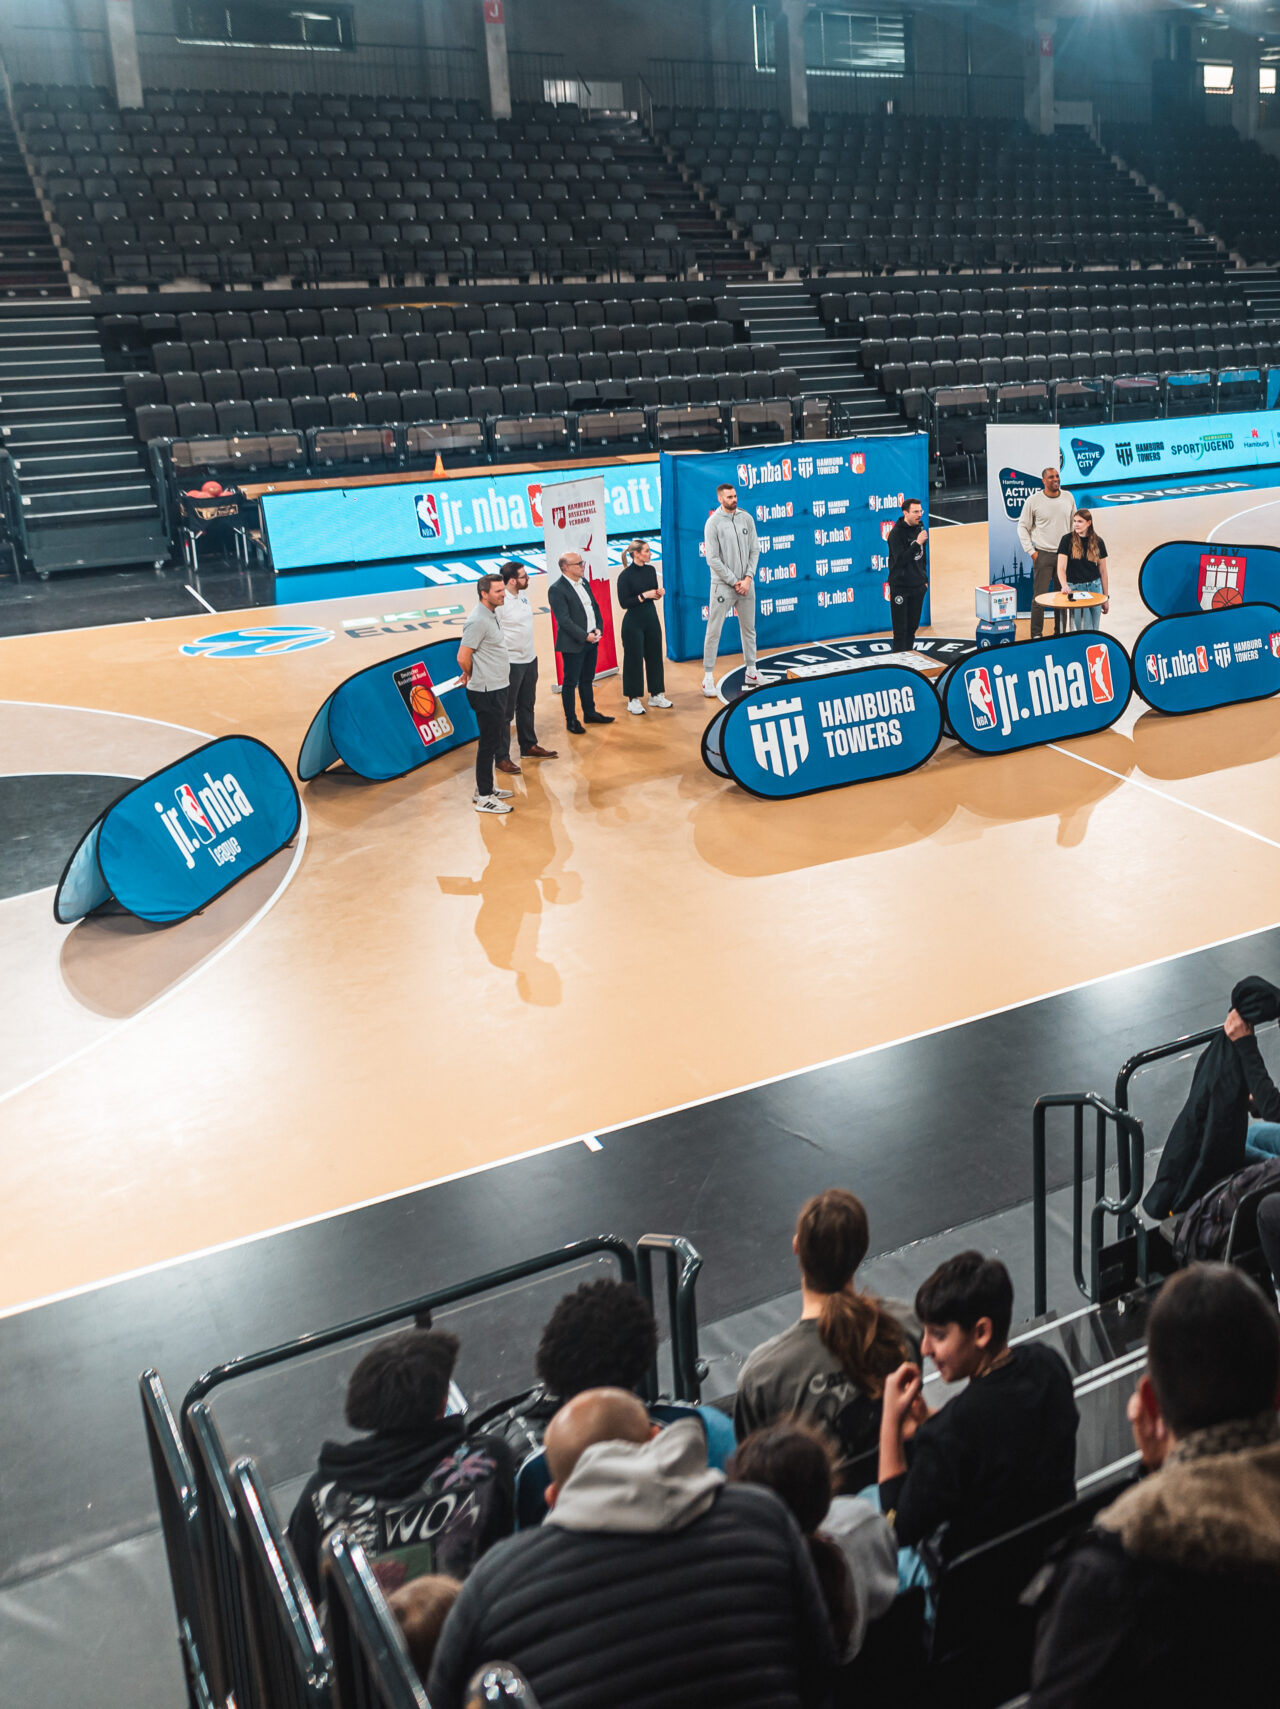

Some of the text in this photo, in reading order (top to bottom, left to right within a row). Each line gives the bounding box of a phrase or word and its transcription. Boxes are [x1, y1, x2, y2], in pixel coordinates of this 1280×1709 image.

[1135, 442, 1165, 453] HAMBURG
[816, 457, 843, 468] HAMBURG
[1077, 452, 1101, 460] ACTIVE
[1137, 452, 1161, 463] TOWERS
[817, 466, 839, 475] TOWERS
[1079, 460, 1094, 468] CITY
[1142, 482, 1250, 497] VEOLIA
[421, 527, 434, 538] NBA
[1233, 638, 1263, 653] HAMBURG
[1235, 650, 1259, 664] TOWERS
[818, 685, 916, 728] HAMBURG
[976, 715, 989, 728] NBA
[419, 716, 451, 742] DBB
[823, 718, 903, 758] TOWERS
[198, 772, 254, 833] nba
[207, 836, 242, 867] League
